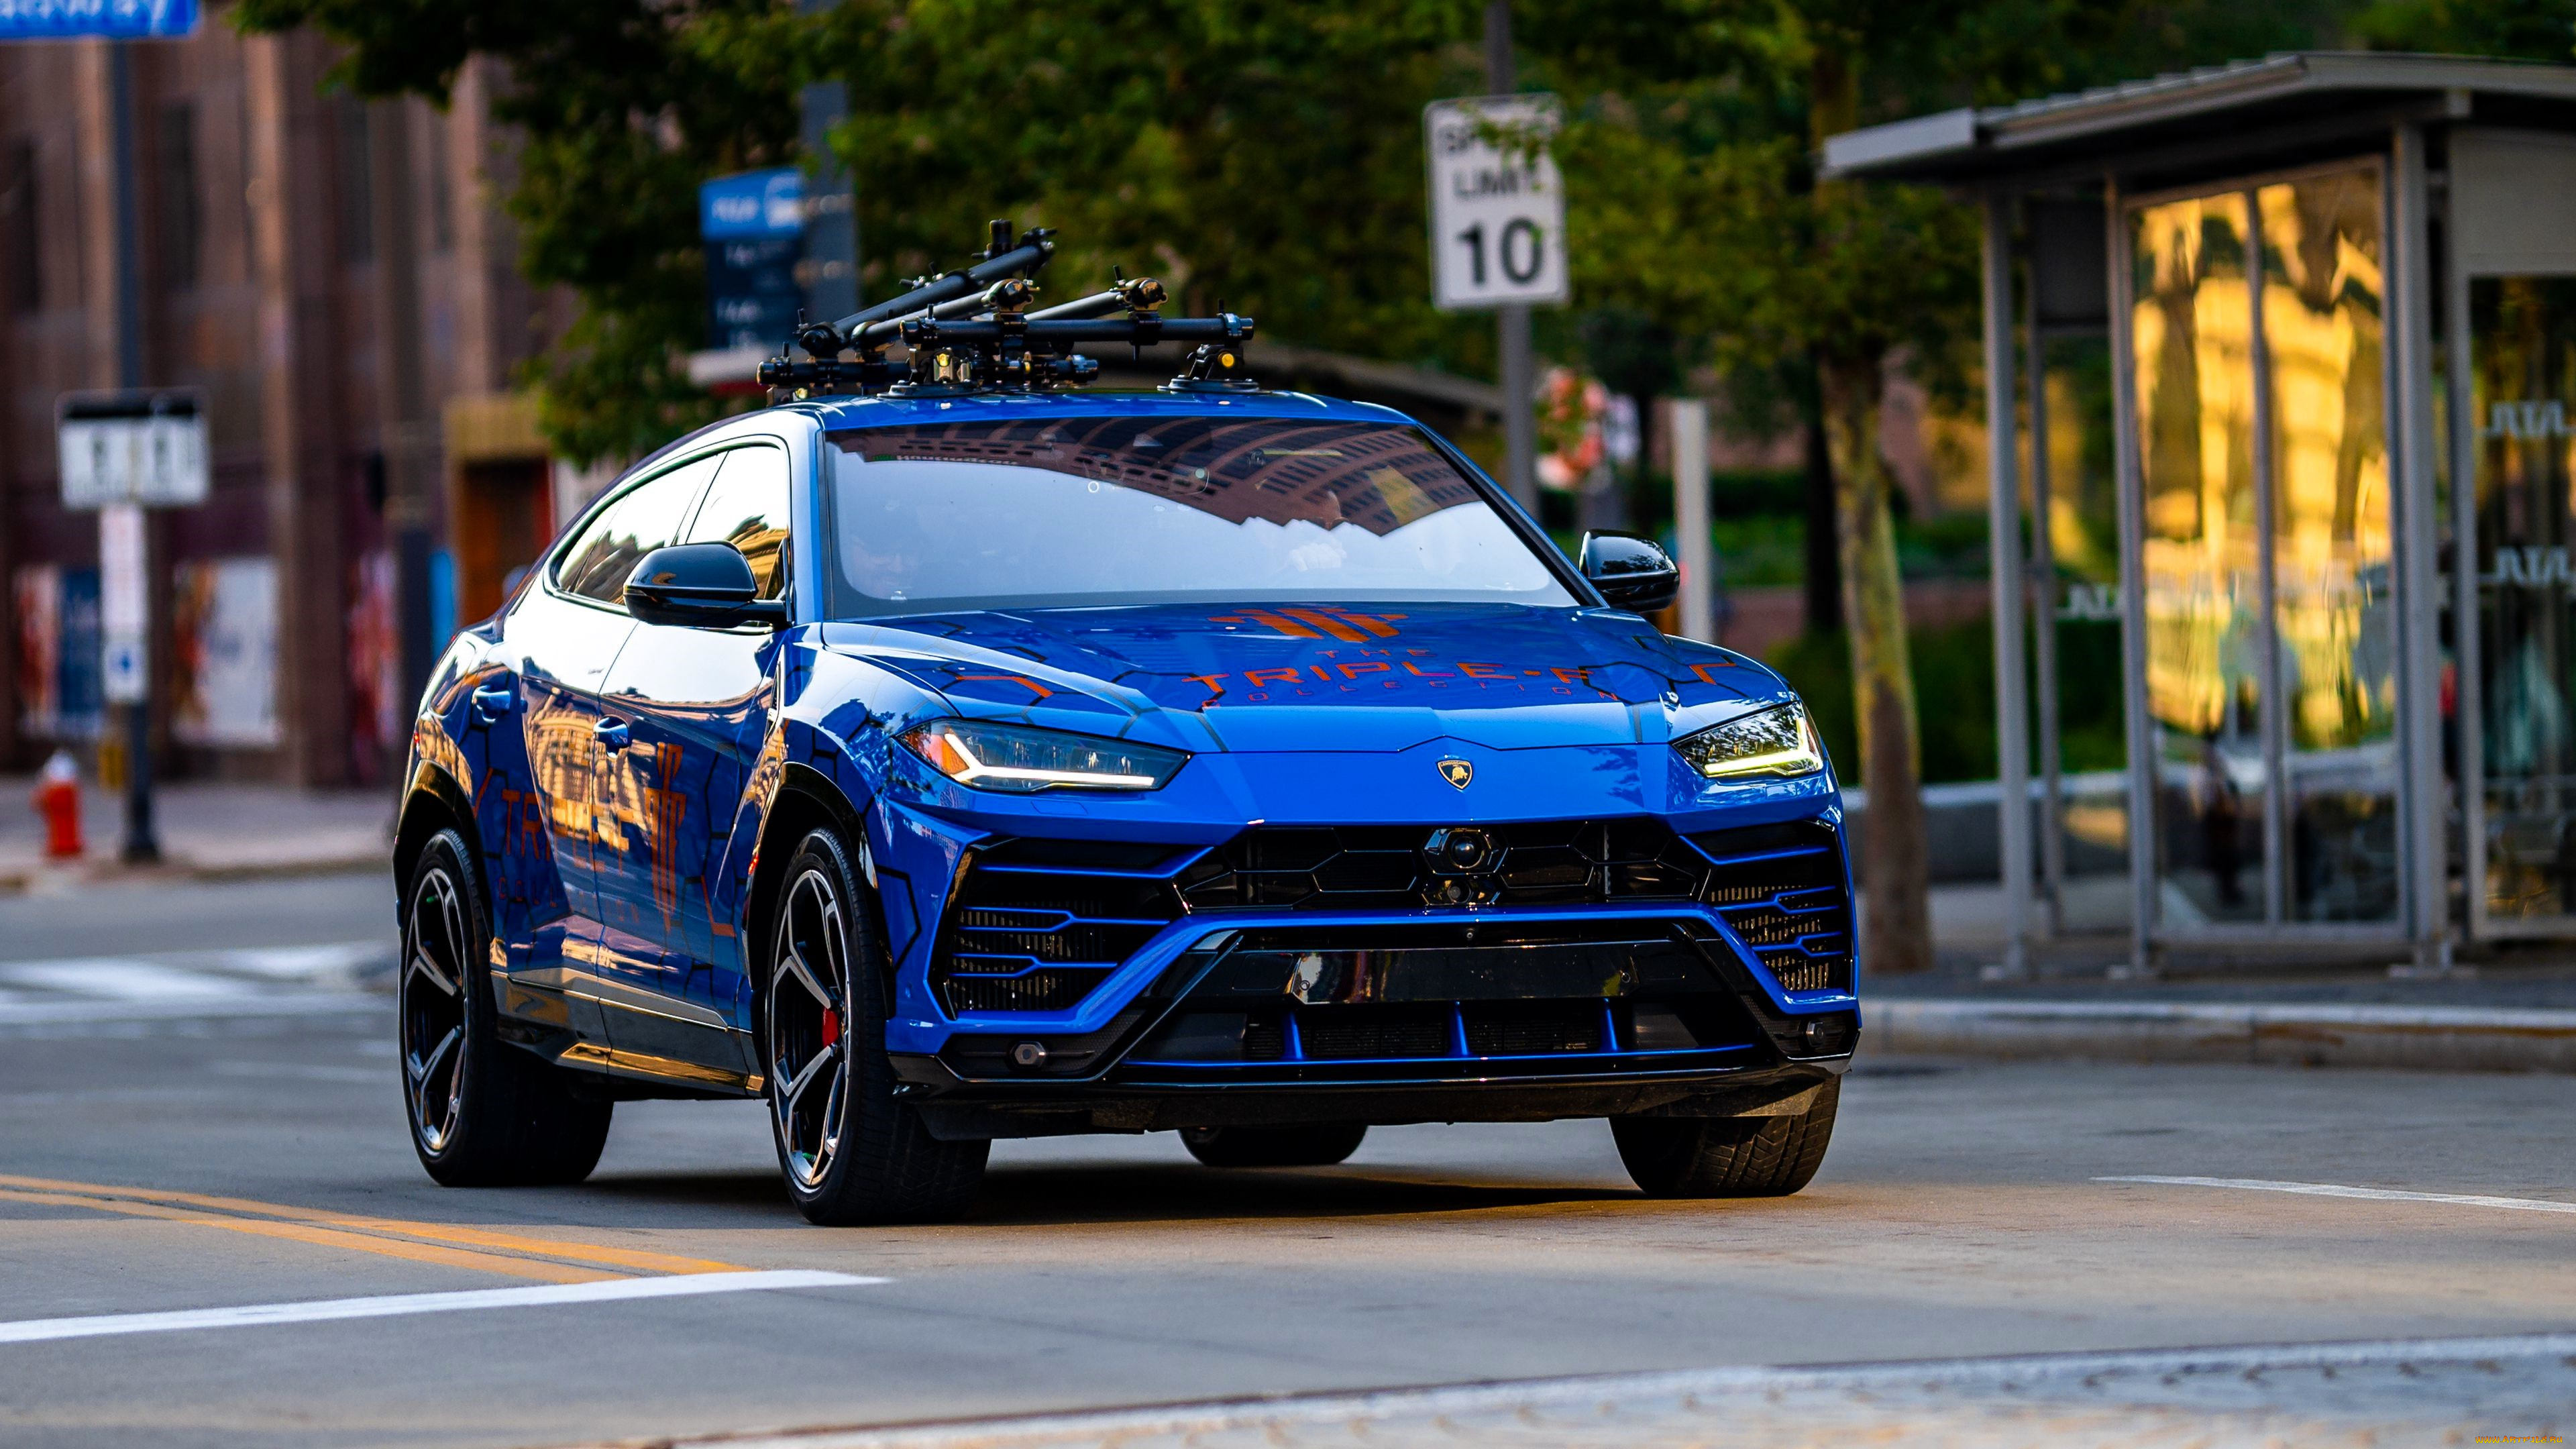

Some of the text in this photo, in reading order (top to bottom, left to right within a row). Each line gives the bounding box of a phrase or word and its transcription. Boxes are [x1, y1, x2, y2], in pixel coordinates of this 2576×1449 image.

[1455, 217, 1546, 287] 10
[1314, 649, 1438, 659] THE
[1181, 661, 1595, 694] TRIPLE-F
[1201, 680, 1619, 708] COLLECTION
[498, 876, 640, 924] COLLCTION
